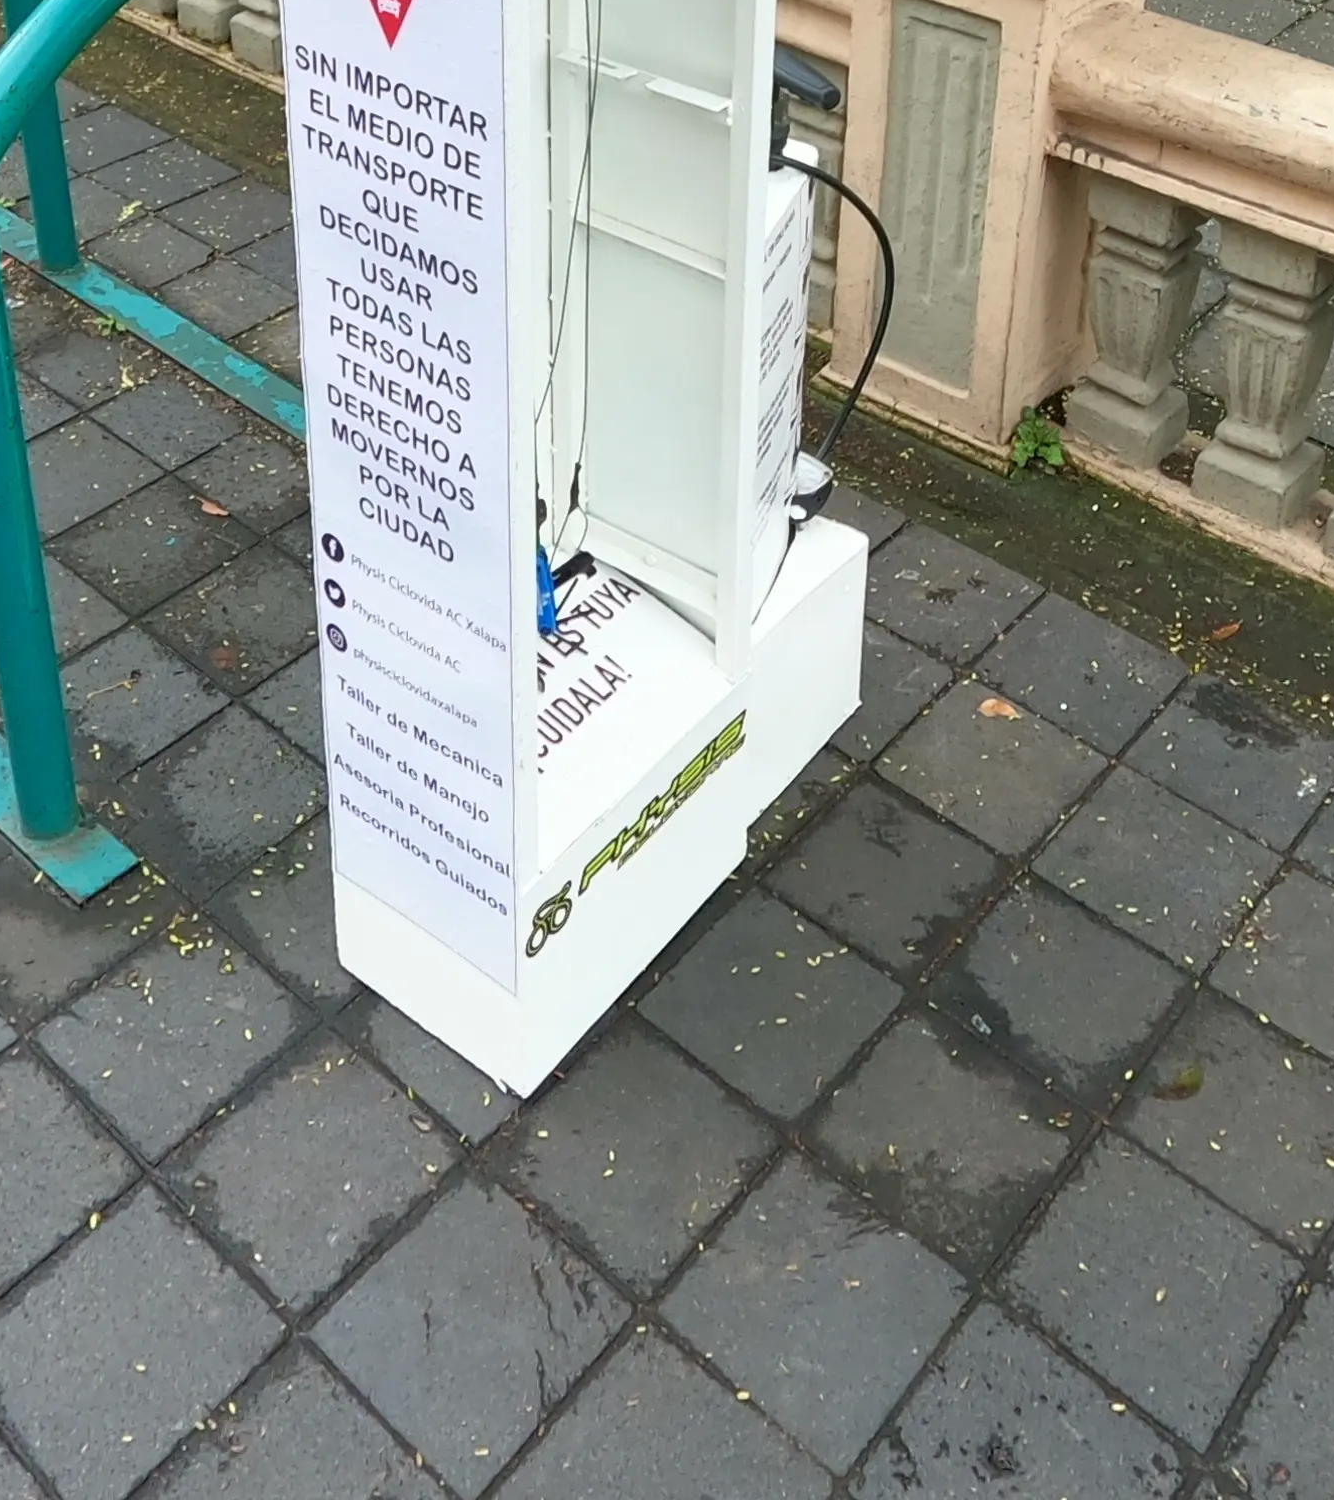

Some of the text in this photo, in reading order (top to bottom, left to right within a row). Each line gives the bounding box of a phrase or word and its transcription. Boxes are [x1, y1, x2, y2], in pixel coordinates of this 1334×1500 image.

[295, 45, 487, 142] SIN IMPORTAR
[310, 88, 481, 180] EL MEDIO DE
[301, 123, 483, 221] TRANSPORTE
[362, 189, 419, 233] QUE
[320, 204, 478, 294] DECIDAMOS
[361, 257, 433, 311] USAR
[326, 277, 472, 365] TODAS LAS
[330, 315, 471, 401] PERSONAS
[327, 383, 476, 480] DERECHO A
[337, 353, 462, 435] TENEMOS
[331, 417, 475, 511] MOVERNOS
[359, 464, 450, 531] POR LA
[359, 497, 455, 562] CIUDAD
[351, 554, 507, 652] Physis Ciclovida AC Xalapa
[352, 599, 462, 673] Physis Ciclovida AC
[337, 674, 504, 788] Taller de Mecanica
[346, 722, 490, 823] Taller de Manejo
[339, 793, 508, 916] Recorridos Guiados
[409, 803, 510, 878] Profesional
